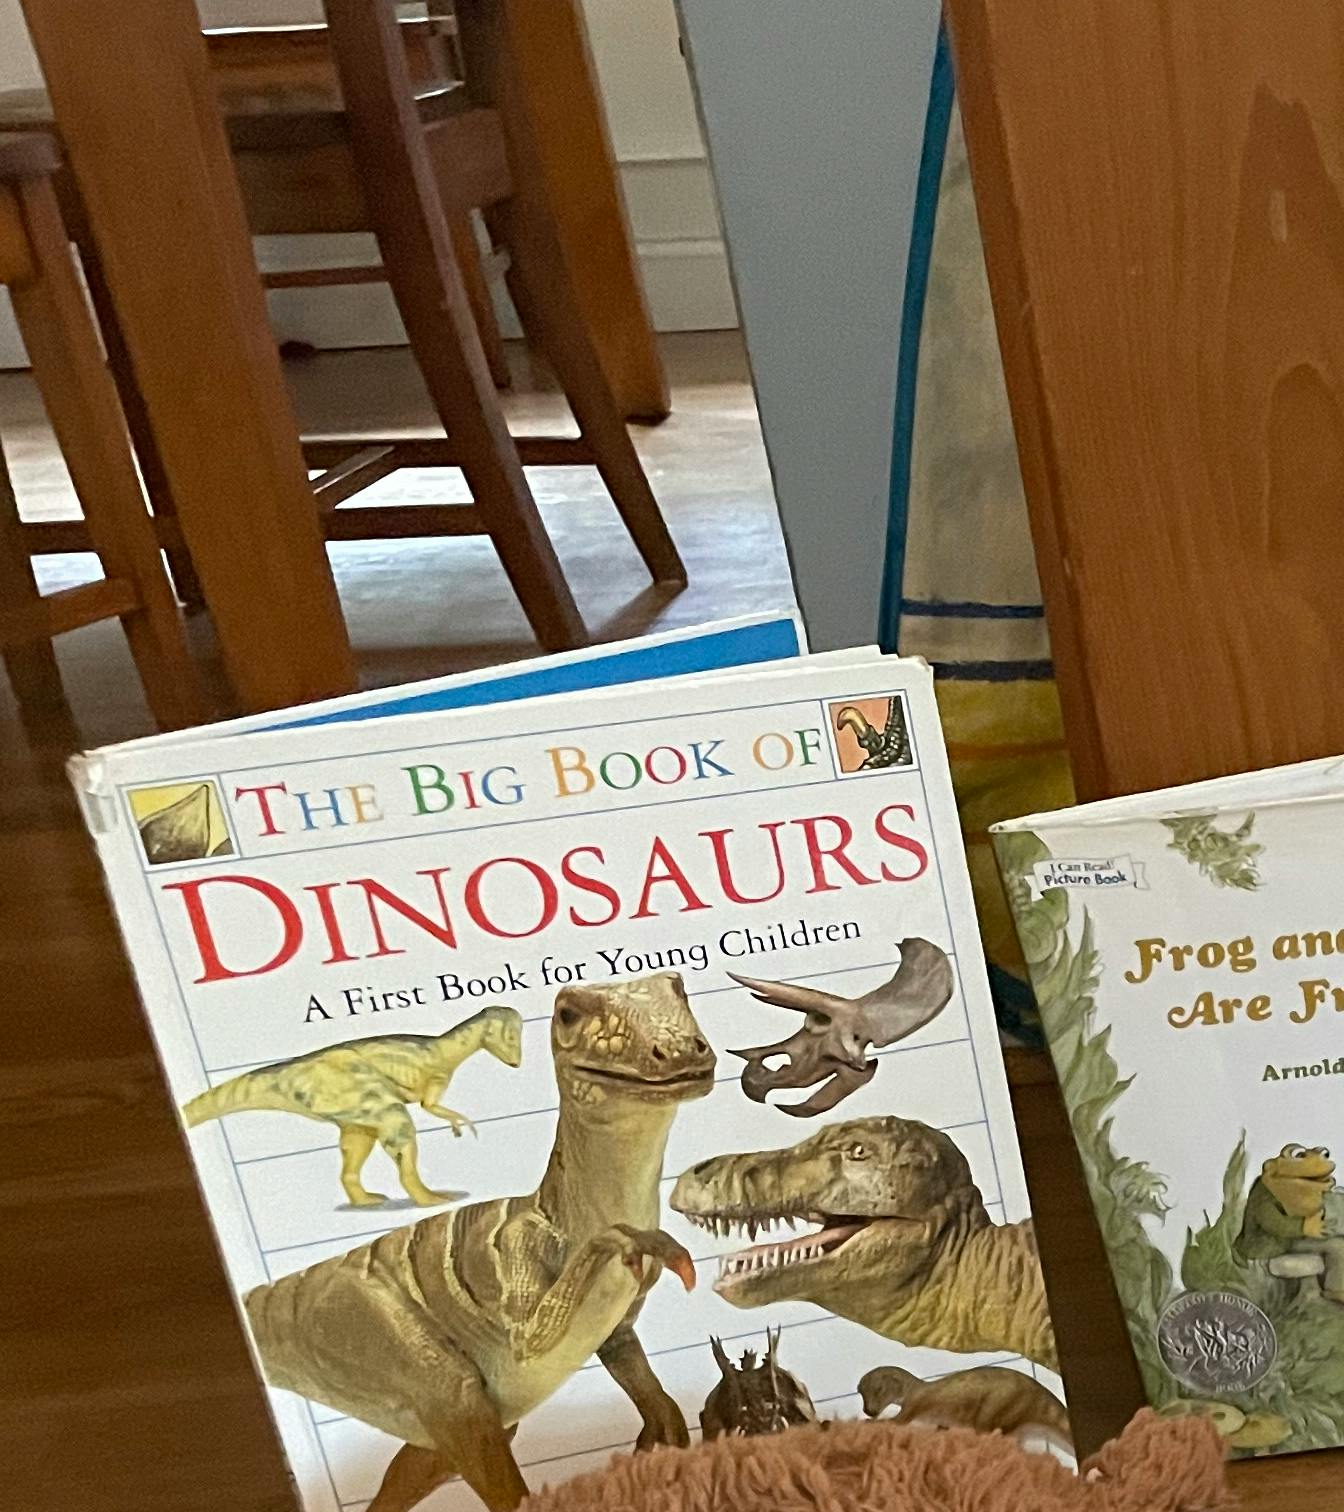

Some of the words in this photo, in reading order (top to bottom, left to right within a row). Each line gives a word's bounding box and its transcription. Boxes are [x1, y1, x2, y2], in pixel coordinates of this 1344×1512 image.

[234, 783, 384, 839] THE
[399, 762, 525, 818] BIG
[545, 737, 735, 801] BOOK
[751, 726, 824, 772] OF
[162, 803, 930, 985] DINOSAURS
[1043, 873, 1091, 887] Picture
[1094, 870, 1128, 885] Book
[303, 993, 331, 1023] A
[343, 983, 426, 1018] First
[437, 965, 529, 1001] Book
[540, 956, 586, 987] for
[599, 939, 711, 976] Young
[719, 918, 862, 959] Children
[1124, 935, 1256, 984] Frog
[1167, 991, 1272, 1030] Are
